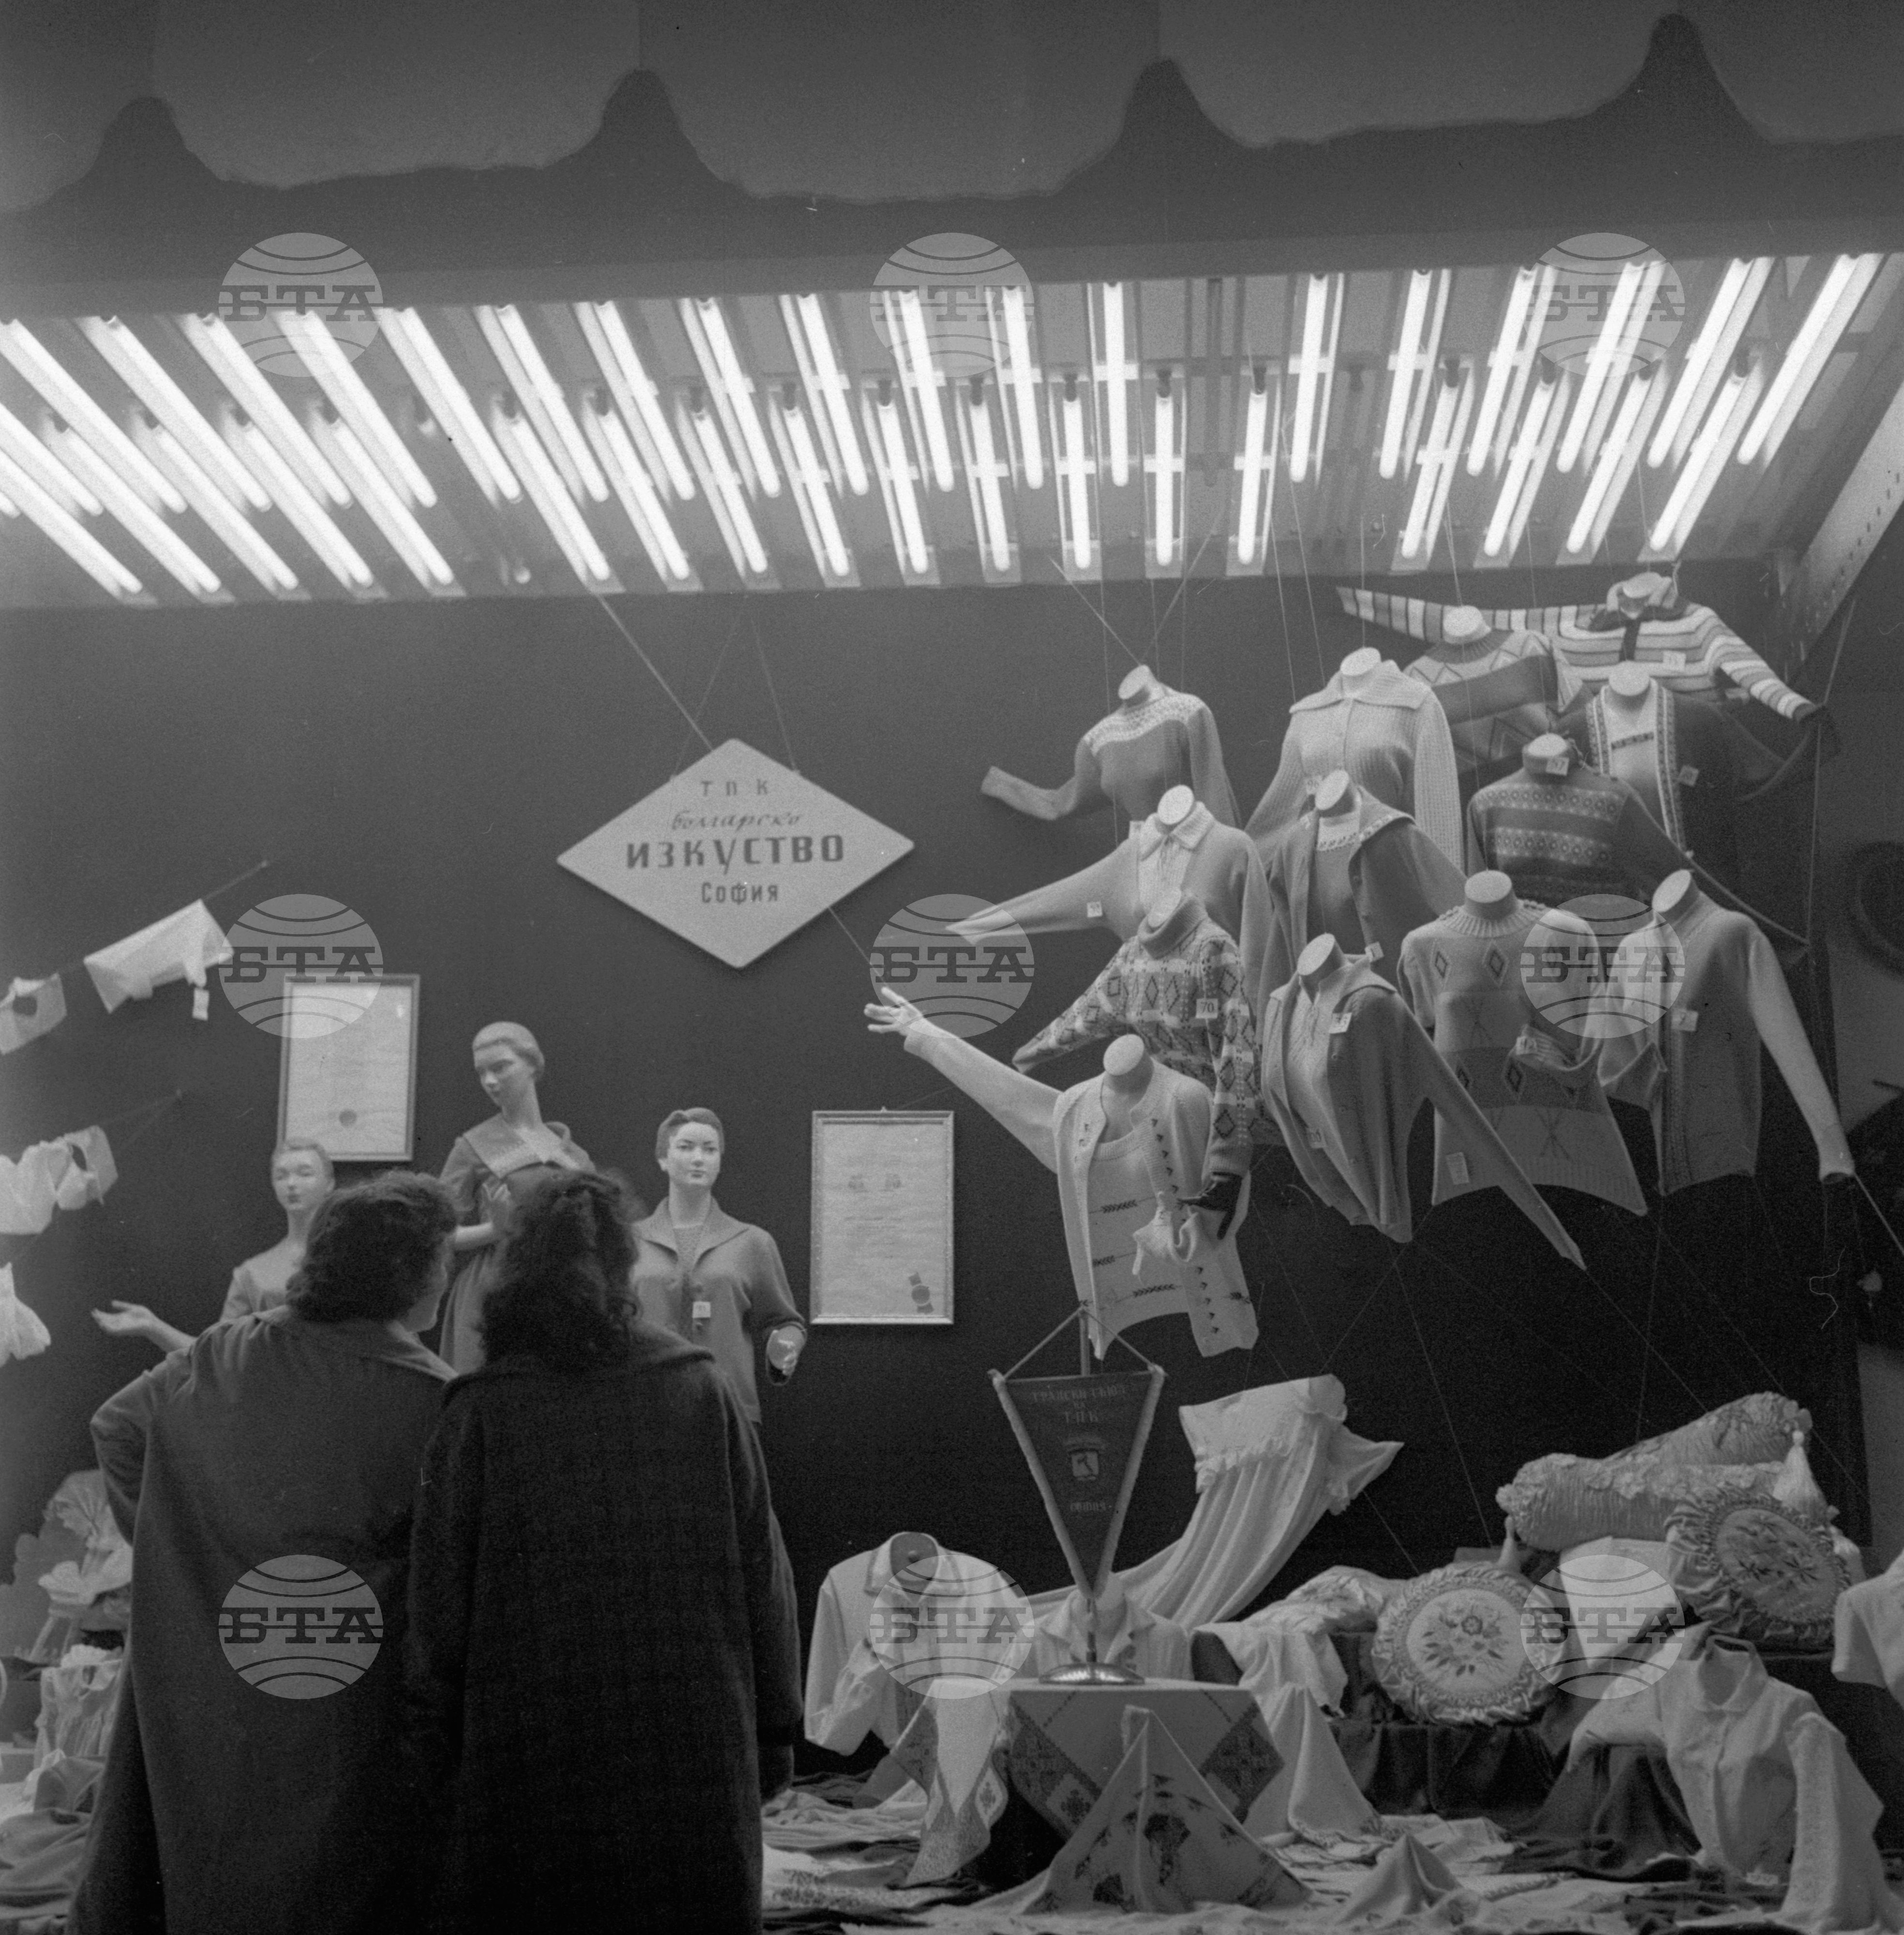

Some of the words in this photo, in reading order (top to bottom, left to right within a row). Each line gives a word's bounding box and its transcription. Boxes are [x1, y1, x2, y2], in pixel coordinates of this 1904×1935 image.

[626, 834, 844, 876] ИЗКУСТВО
[701, 882, 778, 905] София
[1201, 1001, 1215, 1013] 70
